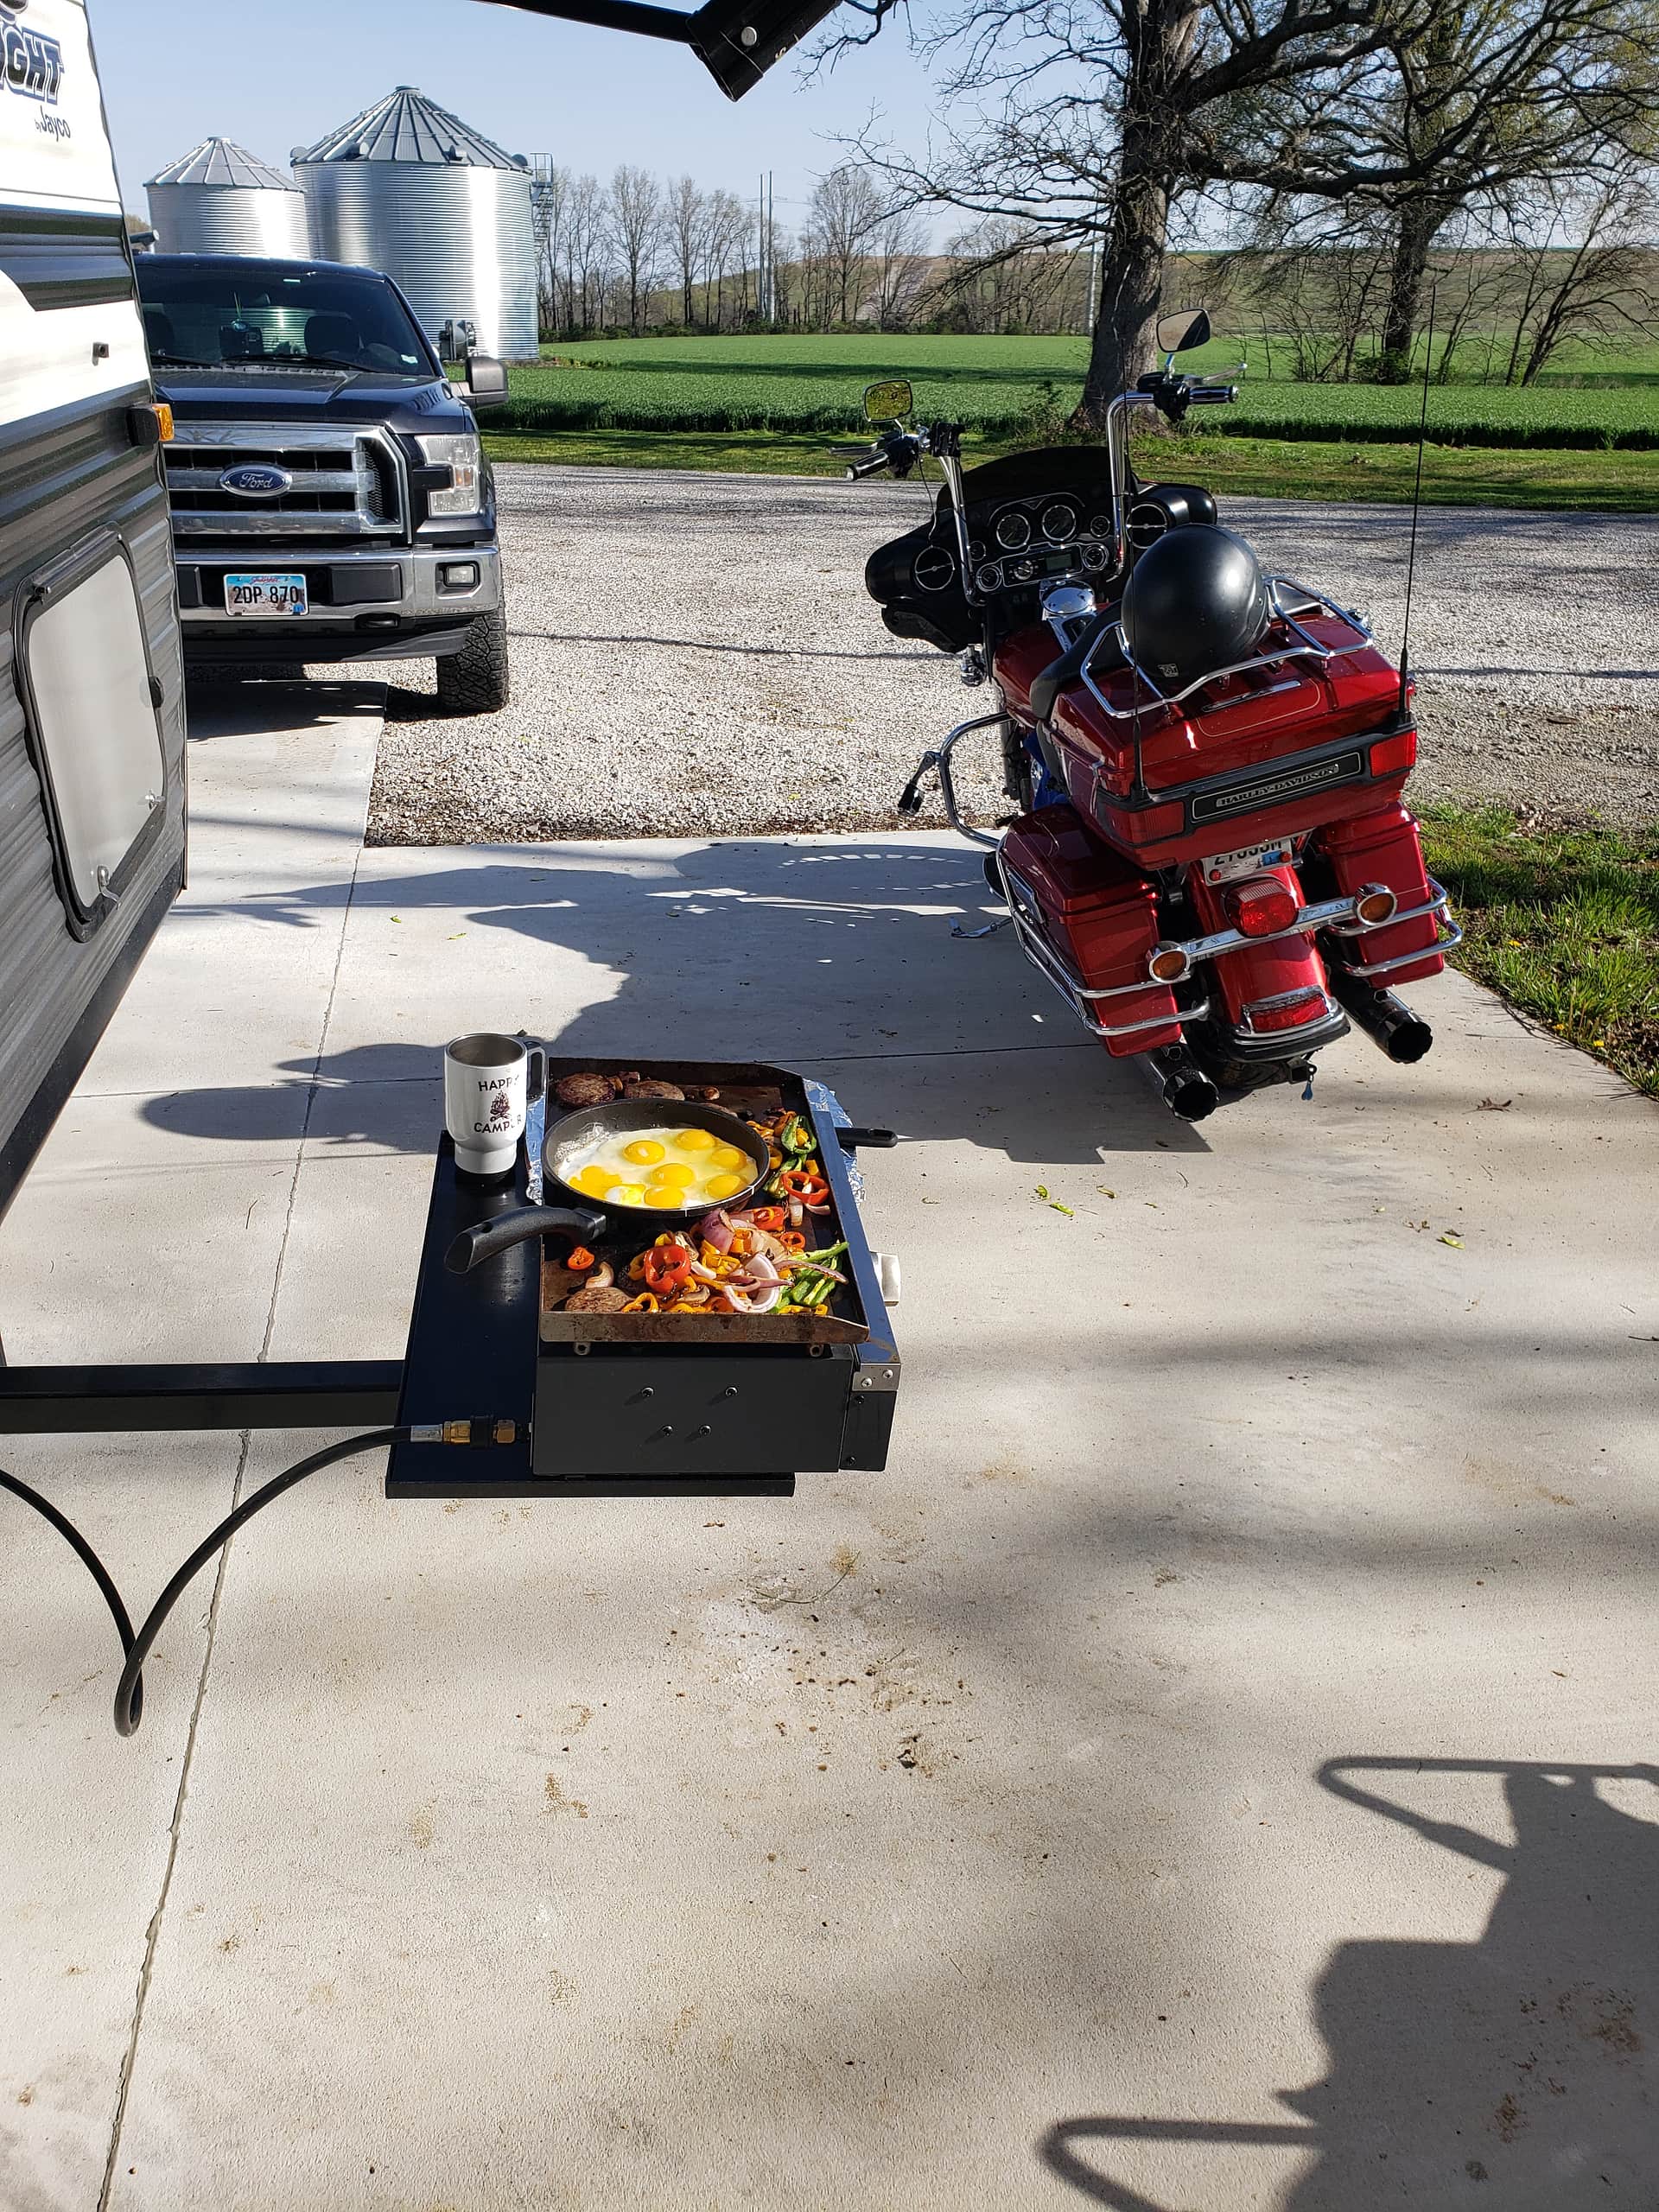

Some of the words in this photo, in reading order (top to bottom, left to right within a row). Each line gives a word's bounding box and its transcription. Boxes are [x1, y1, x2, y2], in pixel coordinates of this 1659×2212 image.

[41, 105, 71, 142] Jayco
[239, 473, 274, 488] Ford
[233, 586, 262, 603] 2DP
[270, 586, 299, 603] 870
[1217, 764, 1338, 806] HARLEY-DAVIDSON
